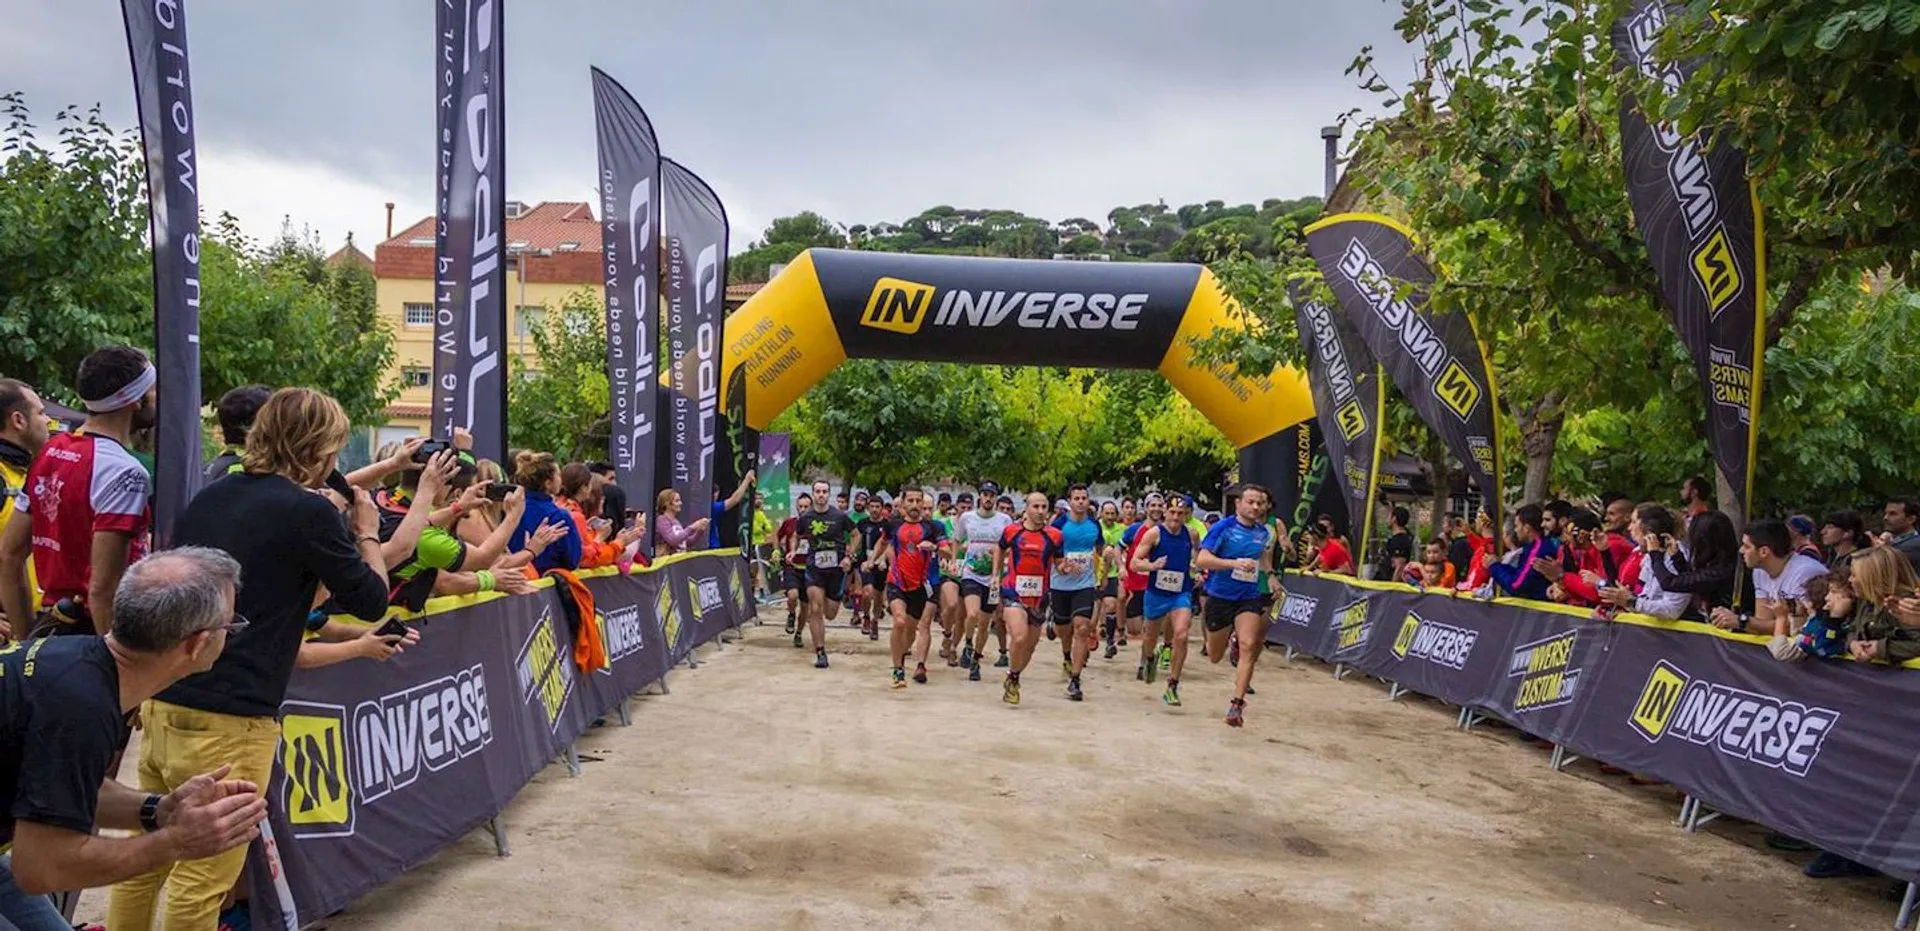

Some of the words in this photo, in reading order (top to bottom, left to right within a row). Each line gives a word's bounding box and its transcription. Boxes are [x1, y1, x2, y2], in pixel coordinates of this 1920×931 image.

[870, 288, 926, 323] IN
[933, 289, 1149, 330] INVERSE
[731, 316, 775, 356] CYCLING
[756, 346, 803, 388] RUNNING
[1279, 596, 1317, 624] INVERSE
[1413, 624, 1473, 664] INVERSE
[293, 727, 341, 813] IN
[358, 674, 490, 789] INVERSE
[1640, 680, 1678, 724] IN
[1675, 687, 1830, 767] INVERSE
